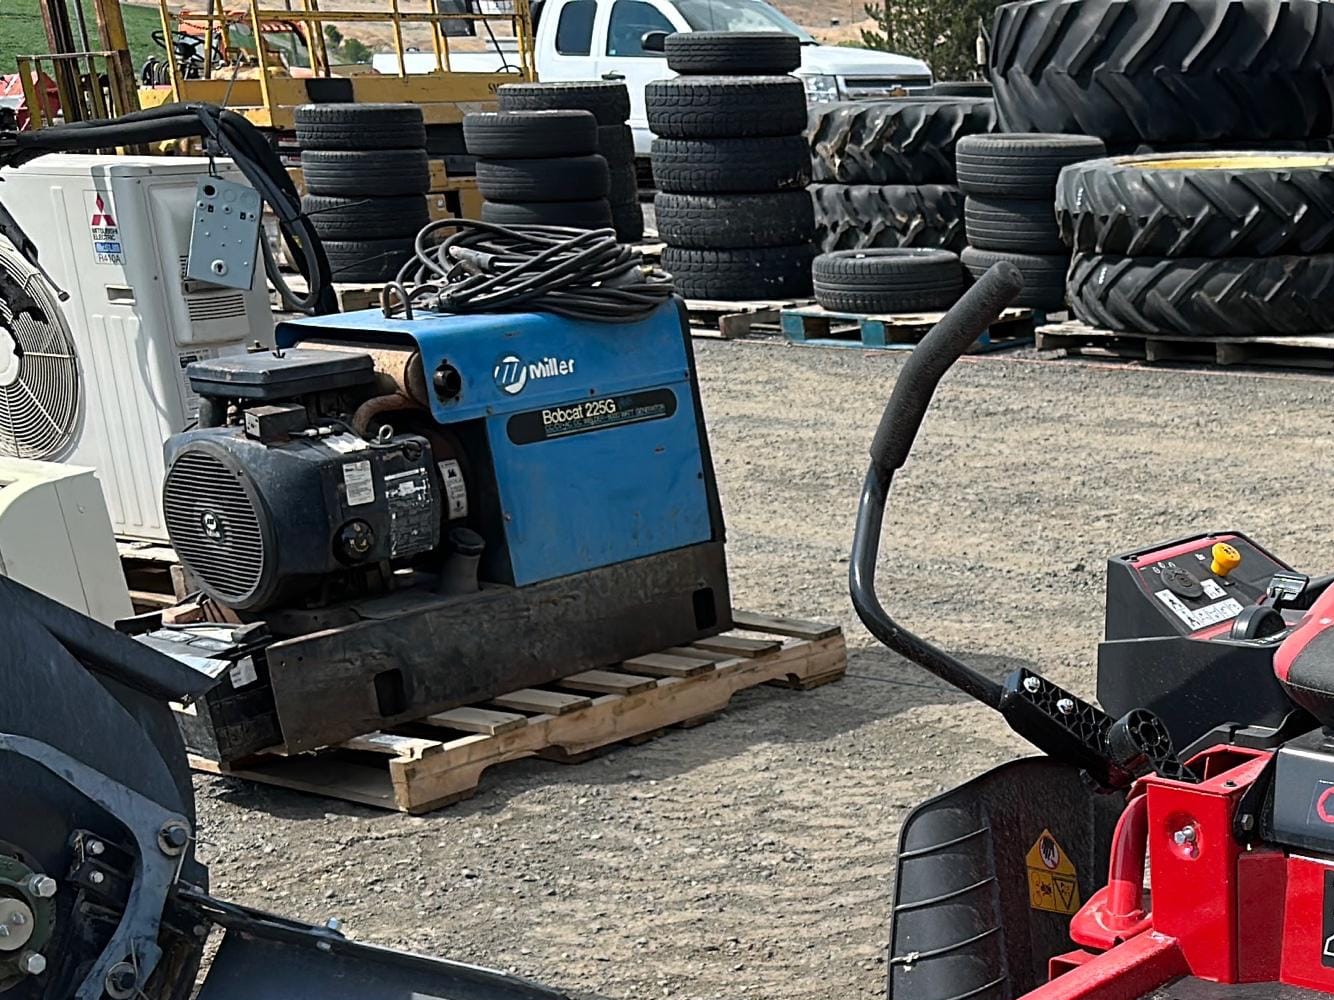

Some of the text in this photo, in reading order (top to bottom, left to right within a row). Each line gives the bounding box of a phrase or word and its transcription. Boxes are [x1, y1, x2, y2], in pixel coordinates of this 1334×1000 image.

[529, 357, 575, 380] Miller
[542, 399, 617, 425] Bobcat 225G
